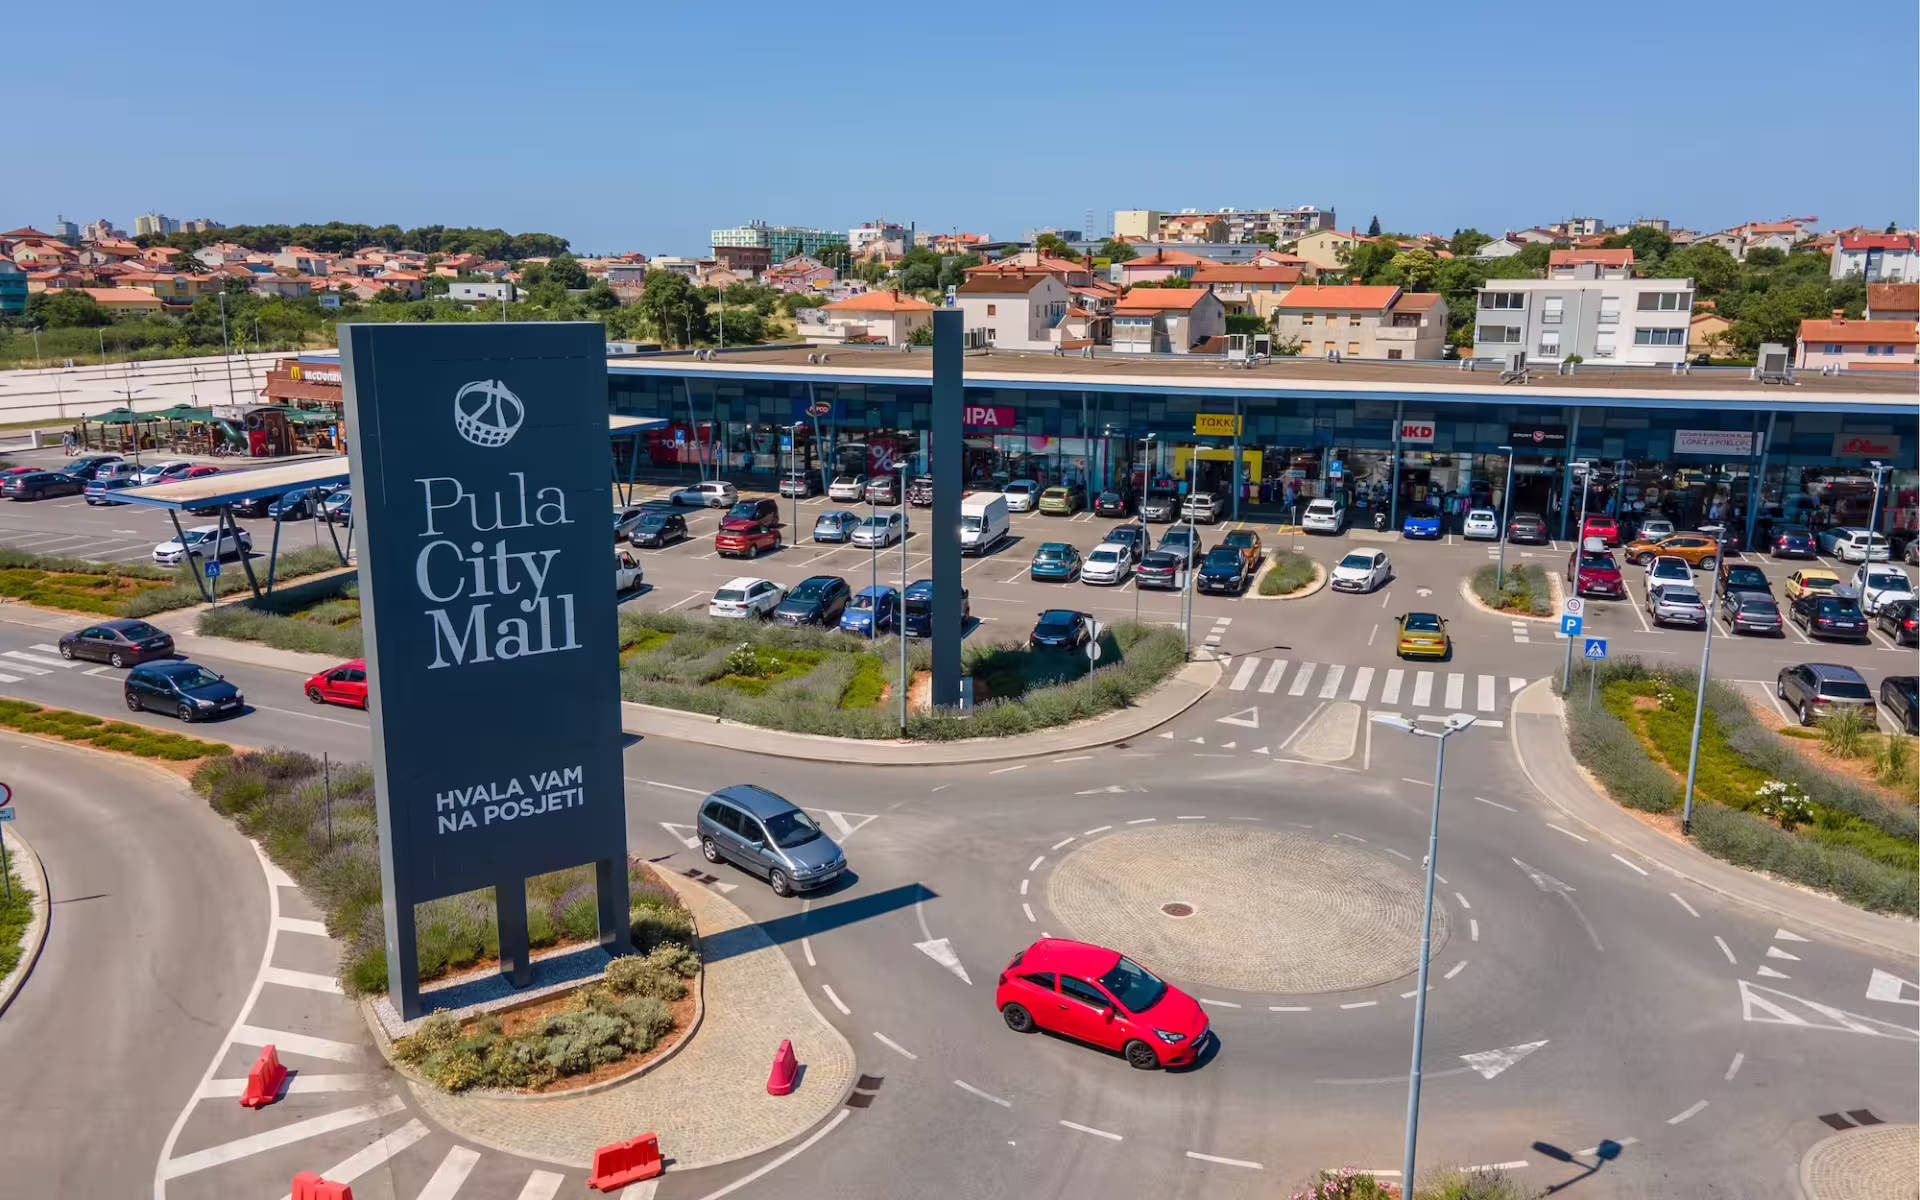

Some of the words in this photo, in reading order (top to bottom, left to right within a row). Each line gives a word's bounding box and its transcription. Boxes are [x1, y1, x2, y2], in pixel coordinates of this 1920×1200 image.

[963, 407, 998, 425] IPA
[414, 472, 575, 537] Pula
[416, 539, 561, 613] City
[424, 594, 583, 669] Mall
[1566, 619, 1576, 631] P
[436, 778, 525, 812] HVALA
[529, 765, 583, 792] VAM
[438, 810, 478, 834] NA
[484, 787, 583, 825] POSJETI
